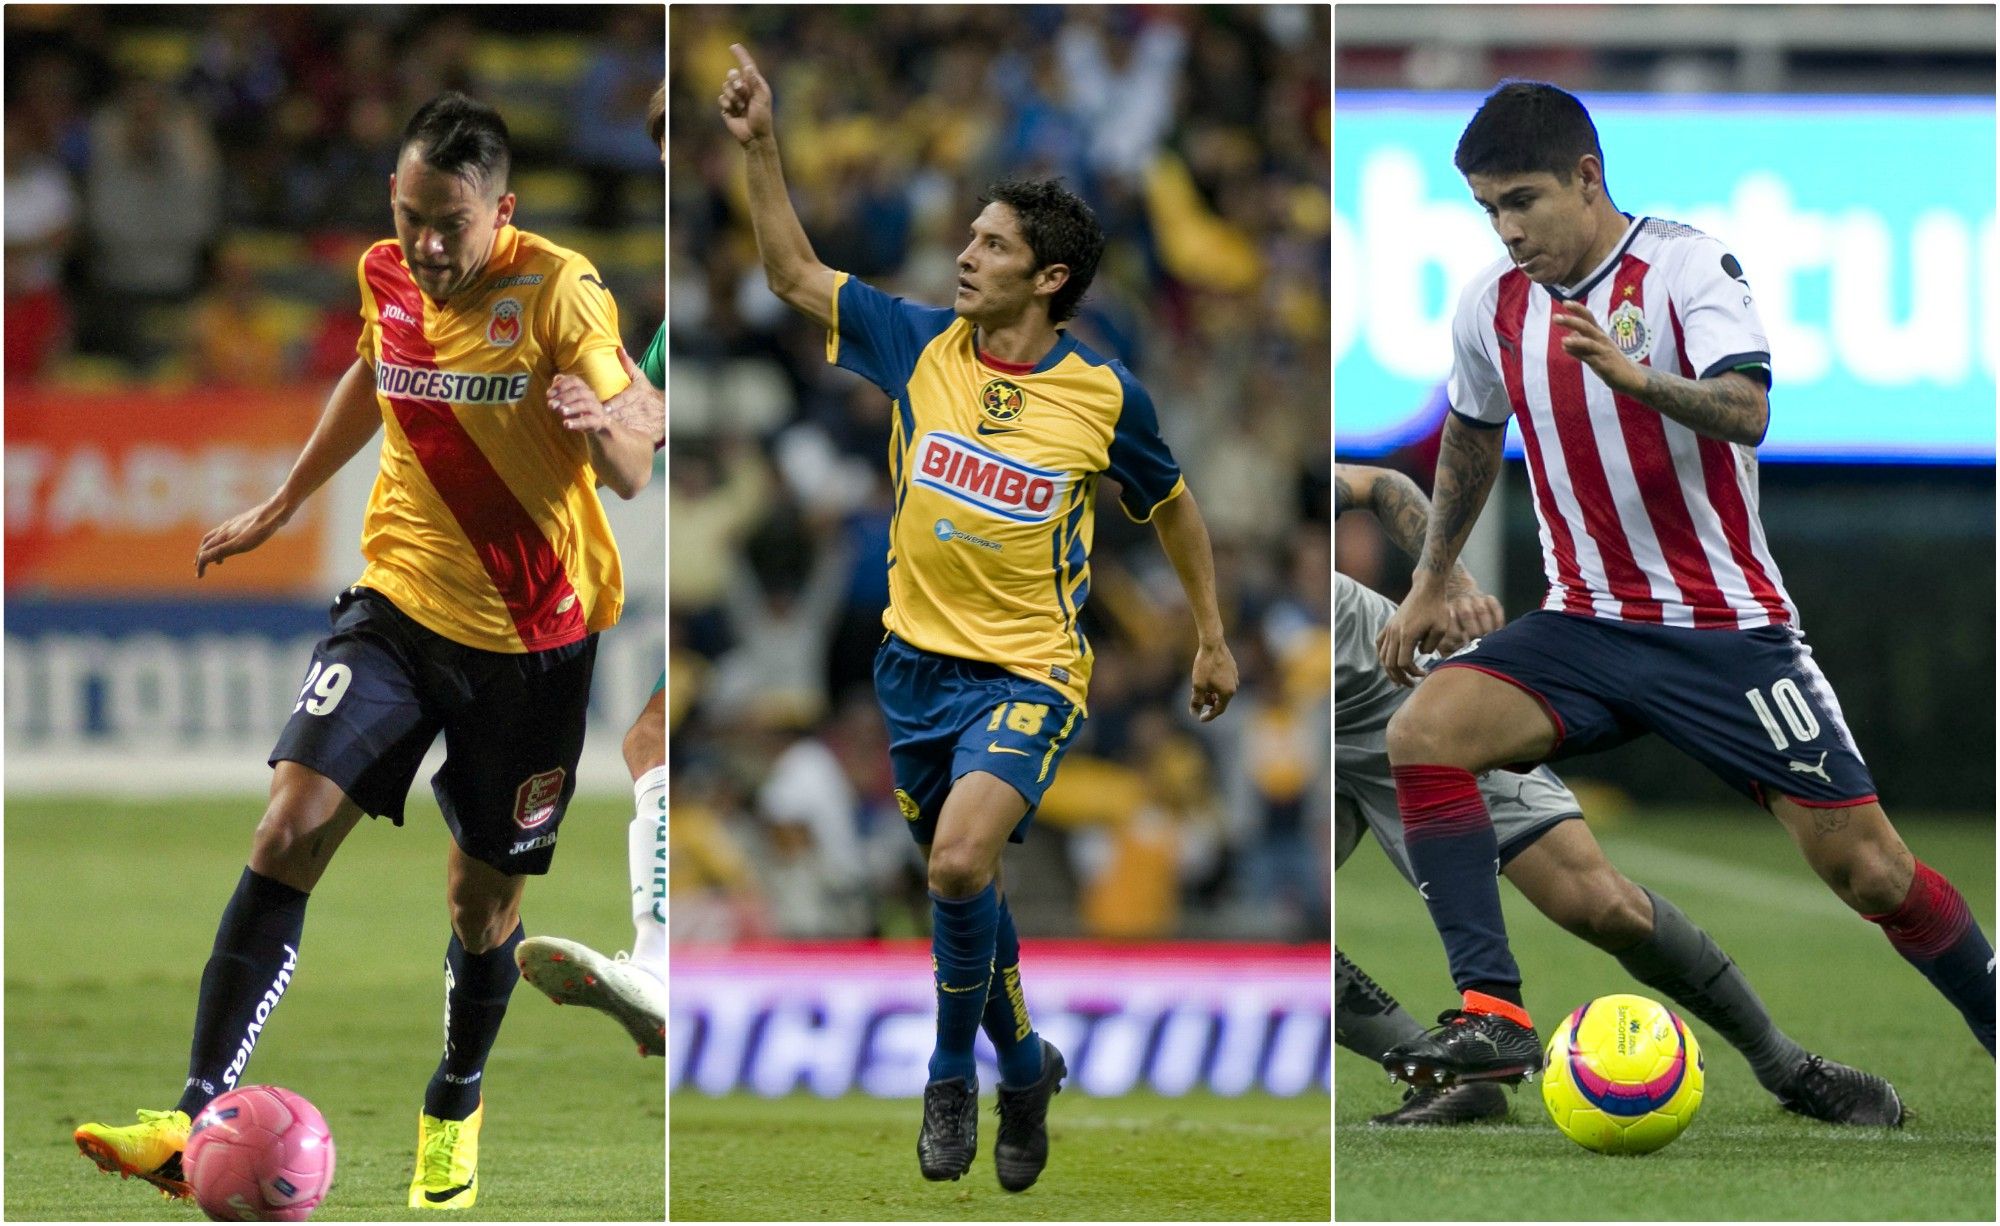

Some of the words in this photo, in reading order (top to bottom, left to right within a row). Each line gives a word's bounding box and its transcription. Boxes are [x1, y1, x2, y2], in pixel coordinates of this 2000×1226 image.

[375, 360, 528, 402] RIDGESTONE
[921, 440, 1055, 513] BIMBO
[986, 701, 1050, 736] 18
[1745, 677, 1821, 751] 10
